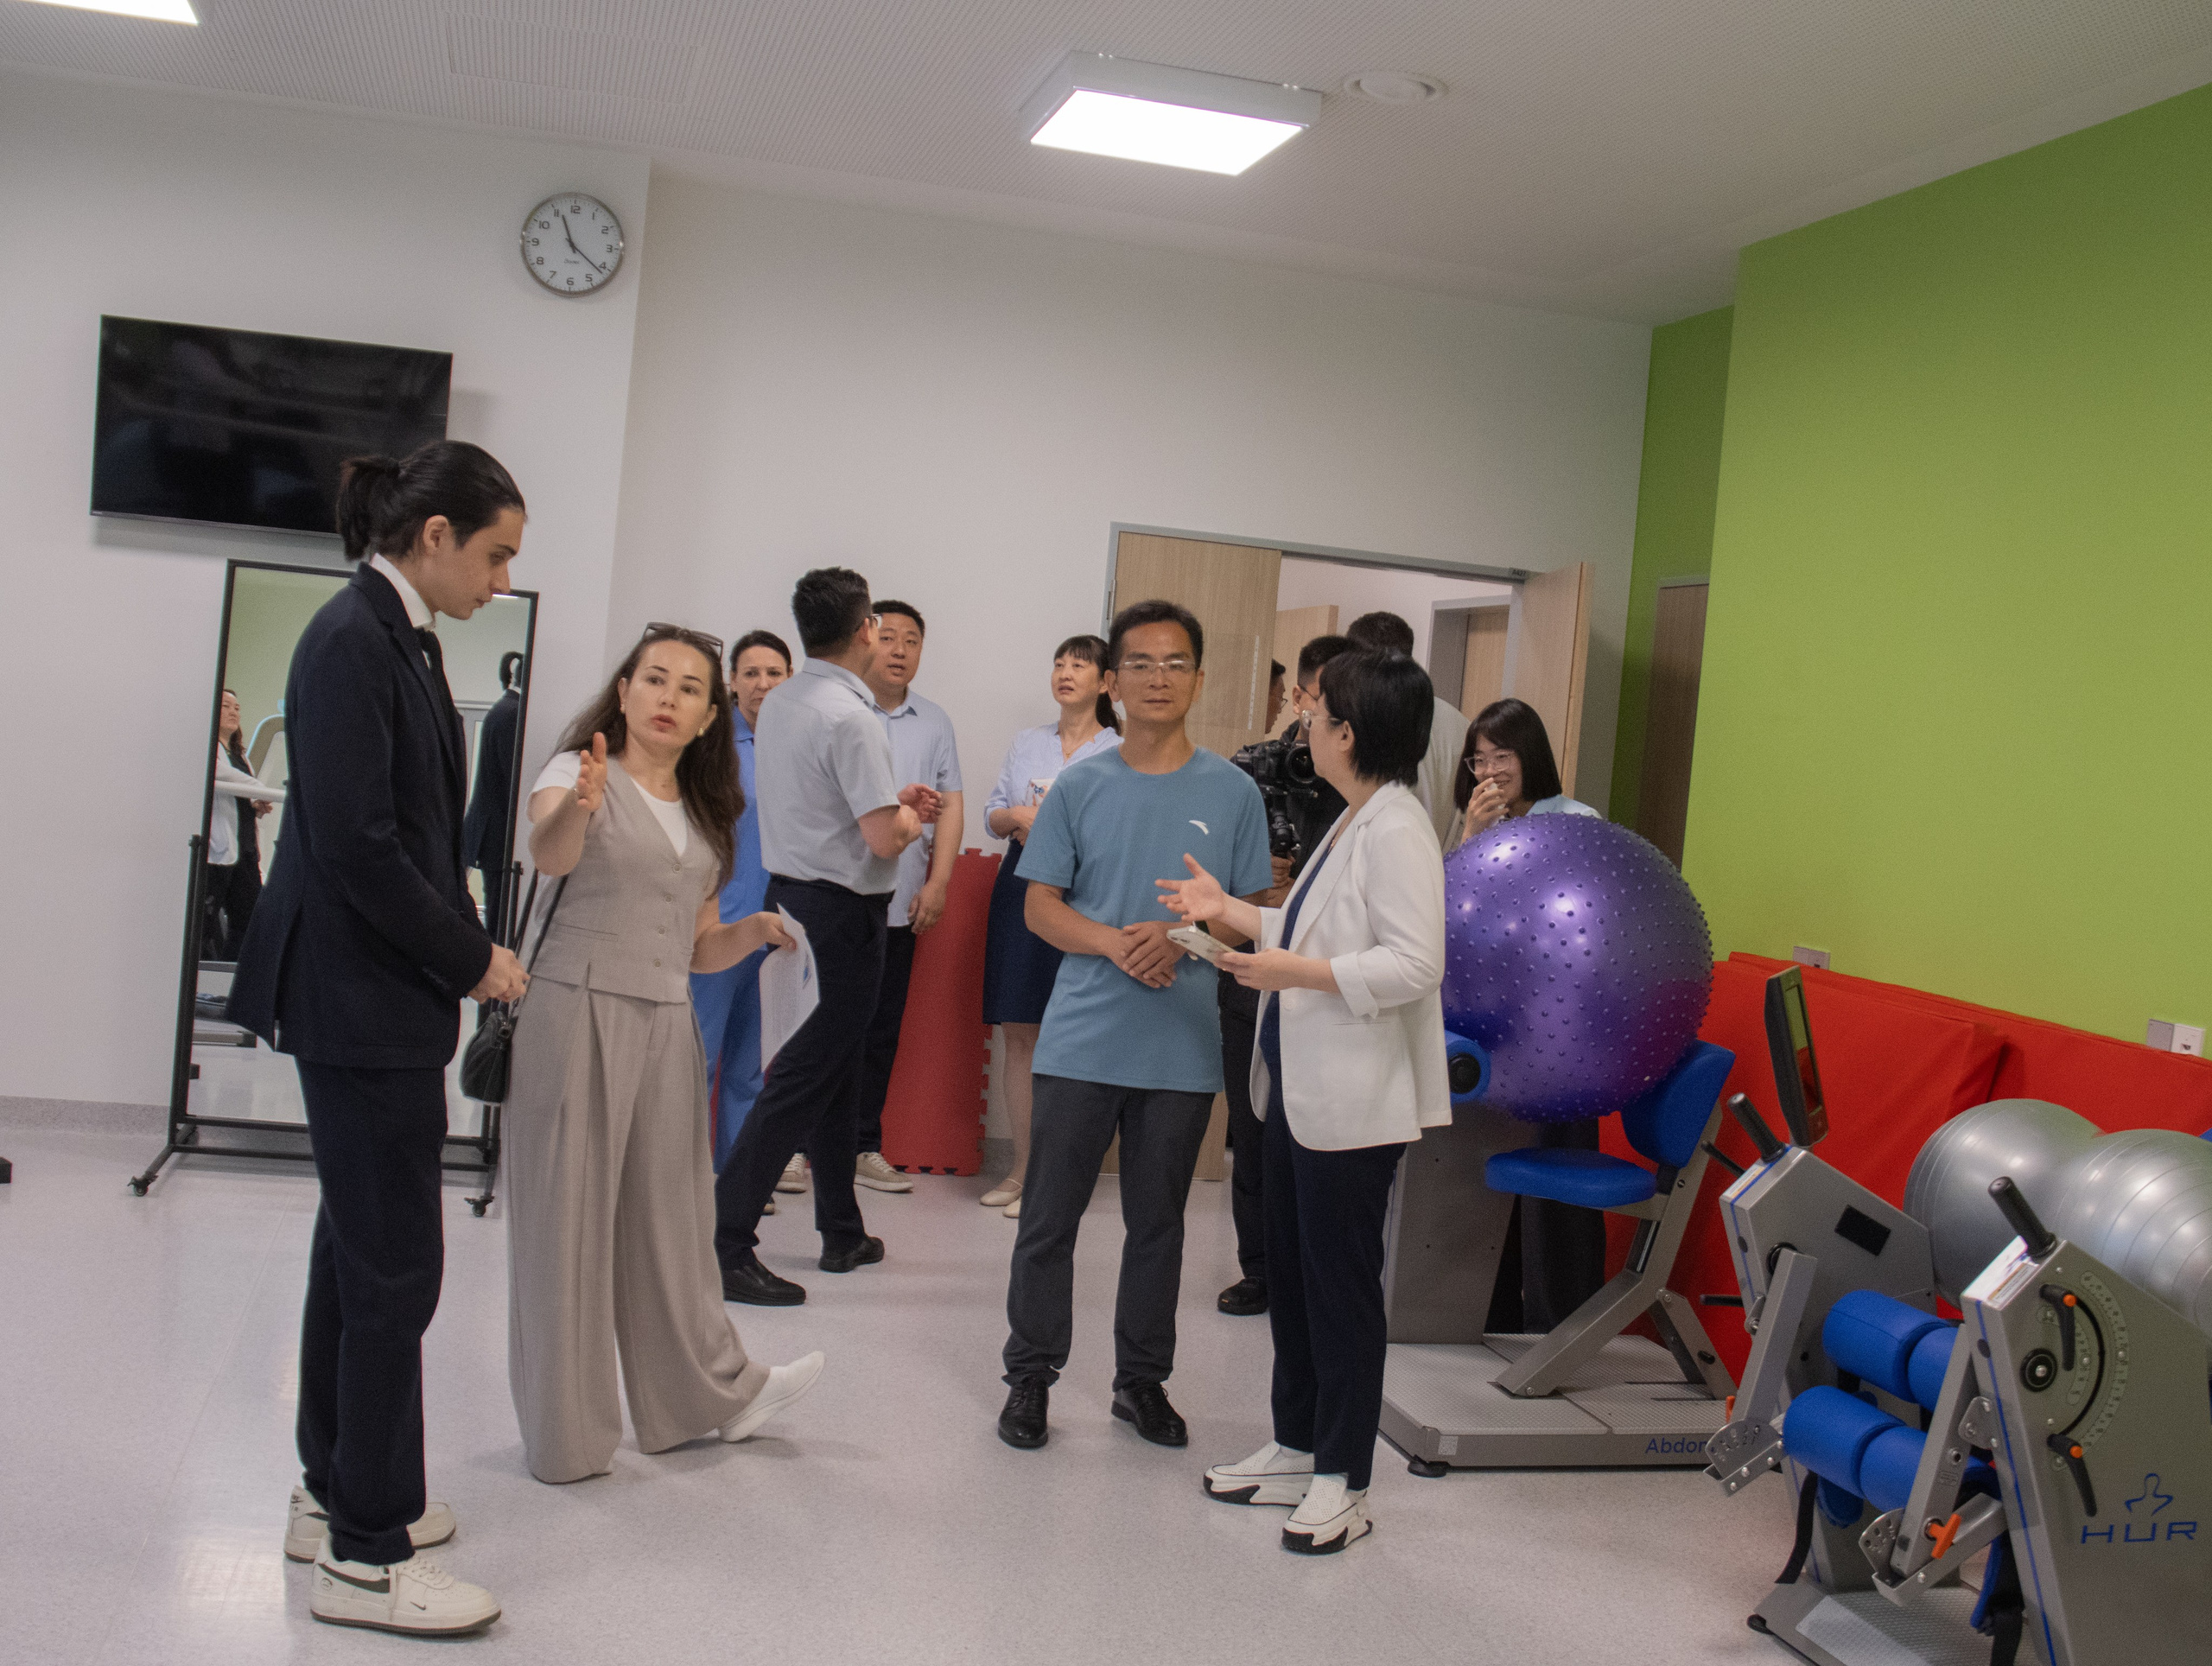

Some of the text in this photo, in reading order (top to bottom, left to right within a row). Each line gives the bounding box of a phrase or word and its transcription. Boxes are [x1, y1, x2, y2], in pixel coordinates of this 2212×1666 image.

[554, 209, 560, 218] 11
[570, 205, 581, 214] 12
[592, 212, 595, 220] 1
[538, 220, 550, 230] 10
[601, 226, 609, 235] 2
[531, 238, 540, 246] 9
[606, 244, 613, 253] 3
[536, 257, 544, 265] 8
[550, 270, 557, 279] 7
[585, 273, 593, 283] 5
[566, 277, 575, 286] 6
[2080, 1520, 2198, 1544] HUR
